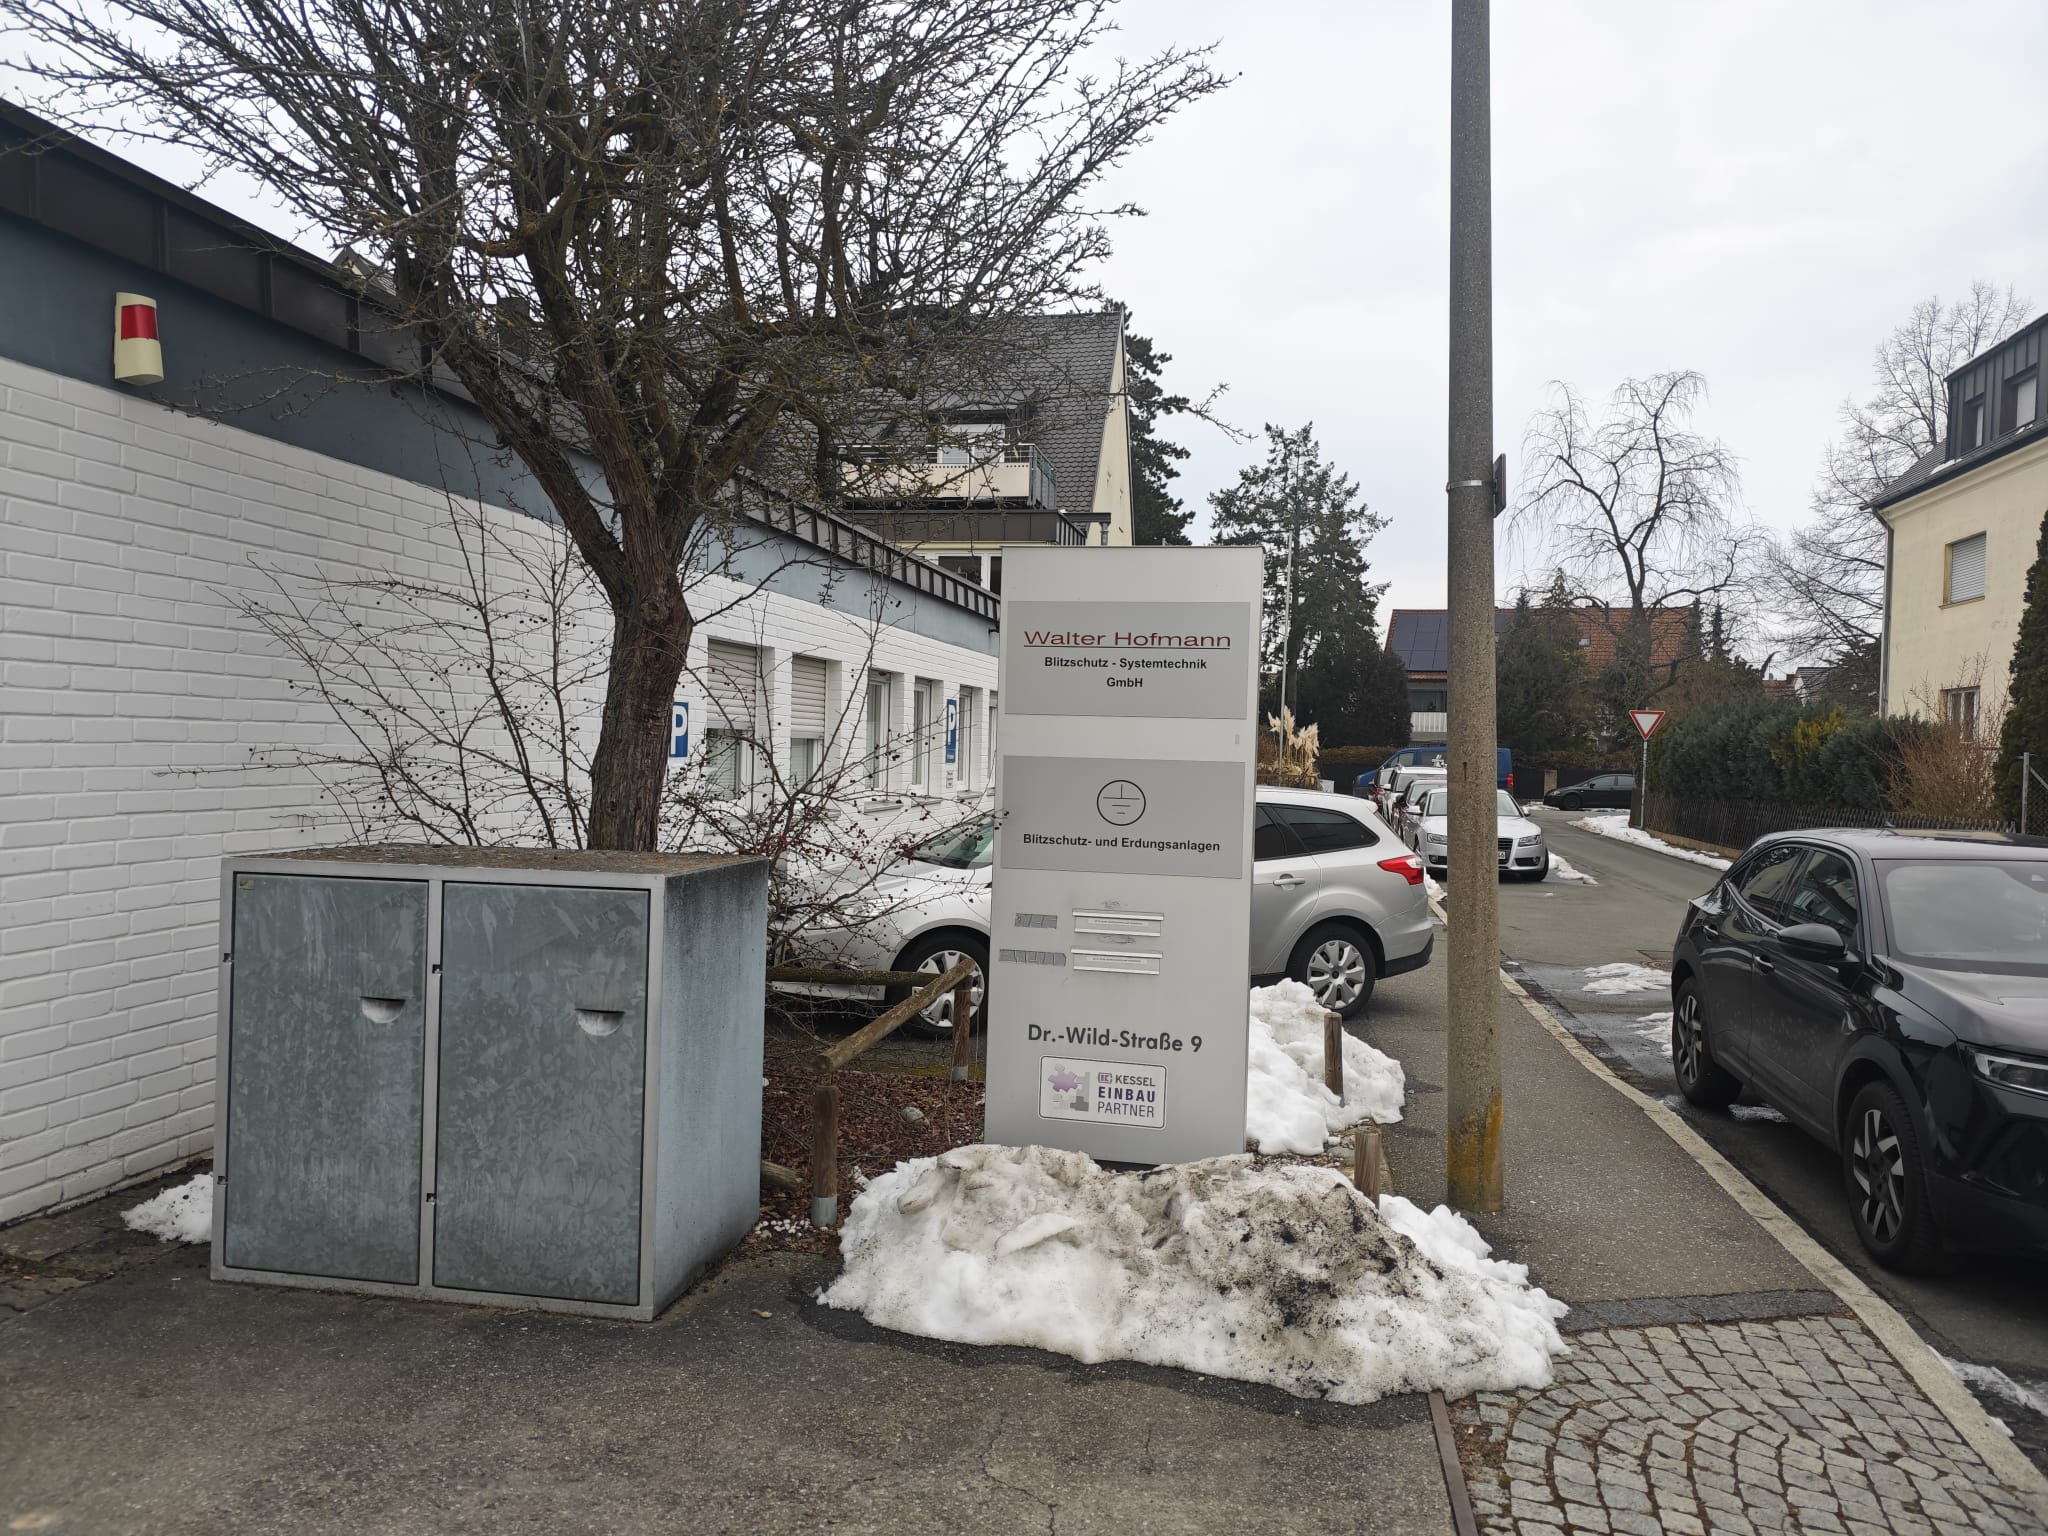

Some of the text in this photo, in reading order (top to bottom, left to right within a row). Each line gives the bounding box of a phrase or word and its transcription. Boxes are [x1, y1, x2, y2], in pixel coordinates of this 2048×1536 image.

[1024, 631, 1231, 647] Walter Hofmann
[1044, 656, 1109, 668] Blitzschutz
[1119, 658, 1207, 671] Systemtechnik
[1106, 677, 1143, 688] GmbH
[670, 705, 687, 755] P
[947, 704, 956, 746] P
[1023, 833, 1220, 852] Blitzschutz- und Erdungsanlagen
[1028, 1024, 1202, 1052] Dr.-Wild-Straße 9
[1115, 1074, 1156, 1087] KESSEL
[1098, 1086, 1155, 1103] EINBAU
[1097, 1101, 1154, 1118] PARTNER
